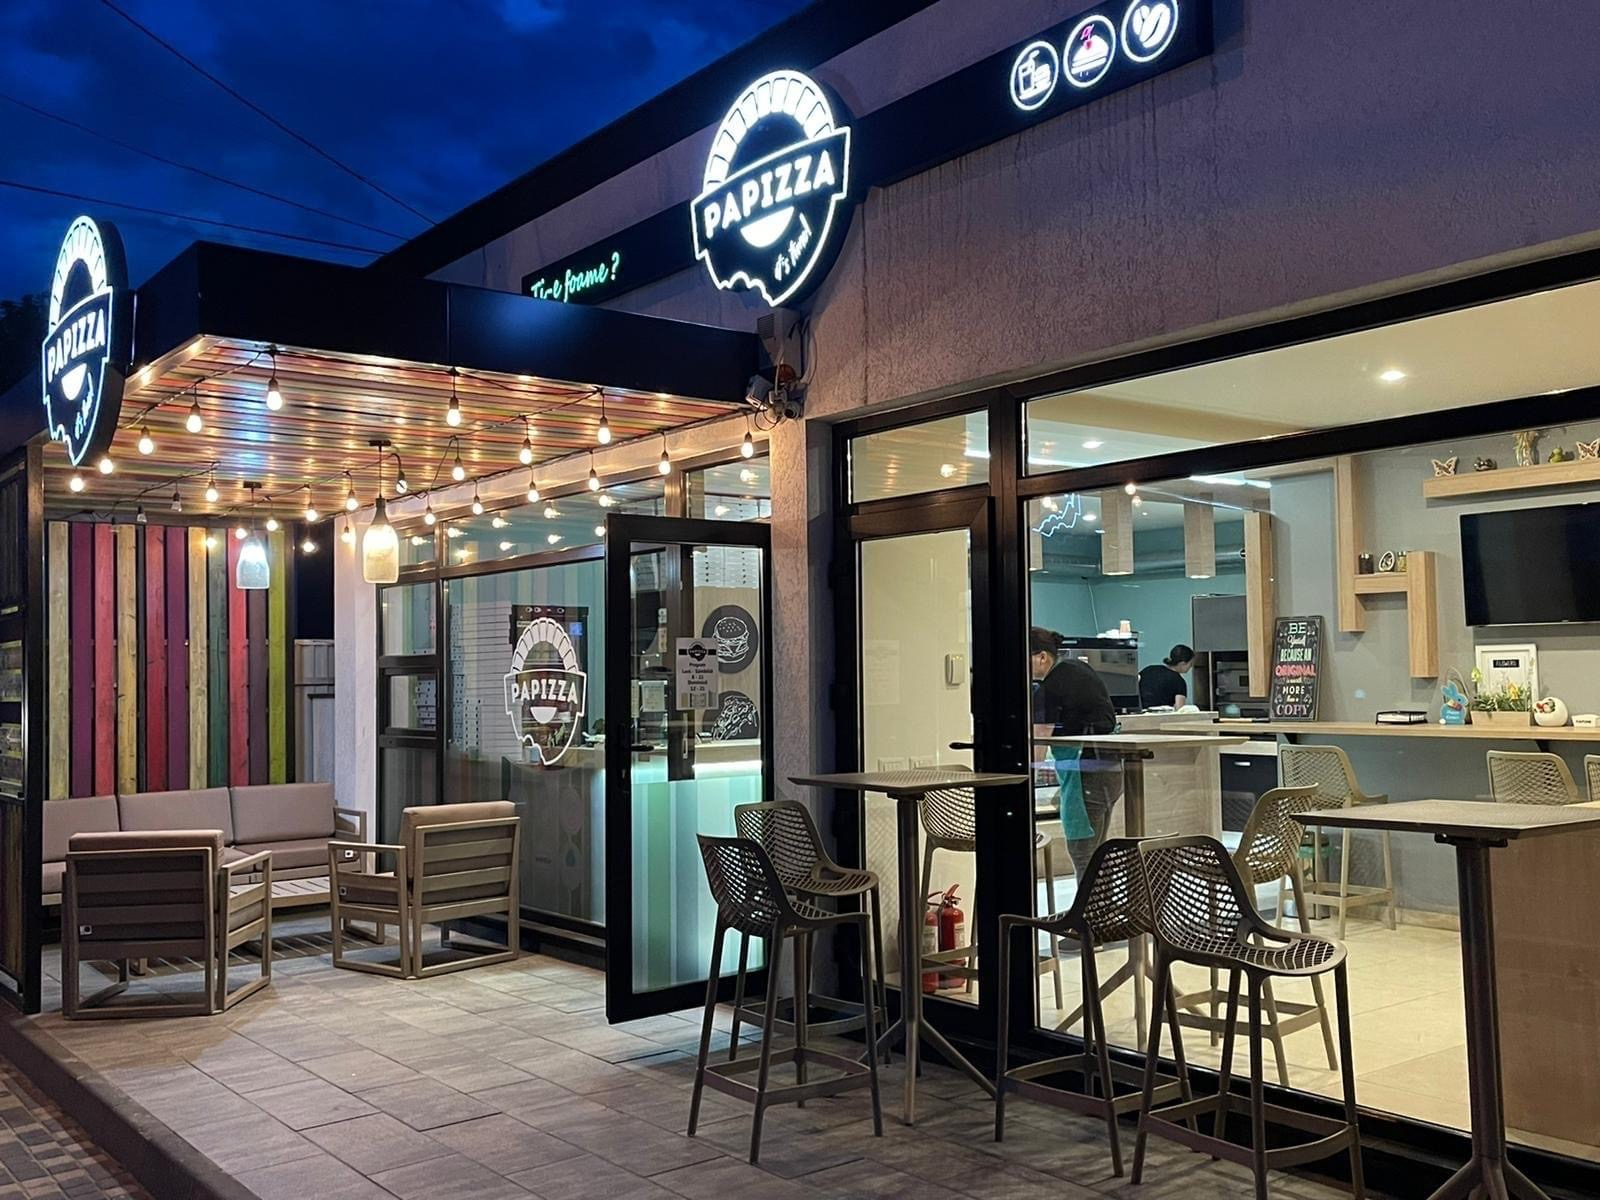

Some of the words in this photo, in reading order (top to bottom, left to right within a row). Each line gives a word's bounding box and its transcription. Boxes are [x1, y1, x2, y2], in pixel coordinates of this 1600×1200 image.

[703, 149, 836, 239] PAPIZZA
[48, 308, 106, 384] PAPIZZA
[1289, 622, 1307, 633] BE
[1275, 665, 1316, 677] ORIGINAL
[511, 678, 579, 705] PAPIZZA
[1282, 686, 1305, 694] MORE
[1276, 704, 1309, 715] COPY
